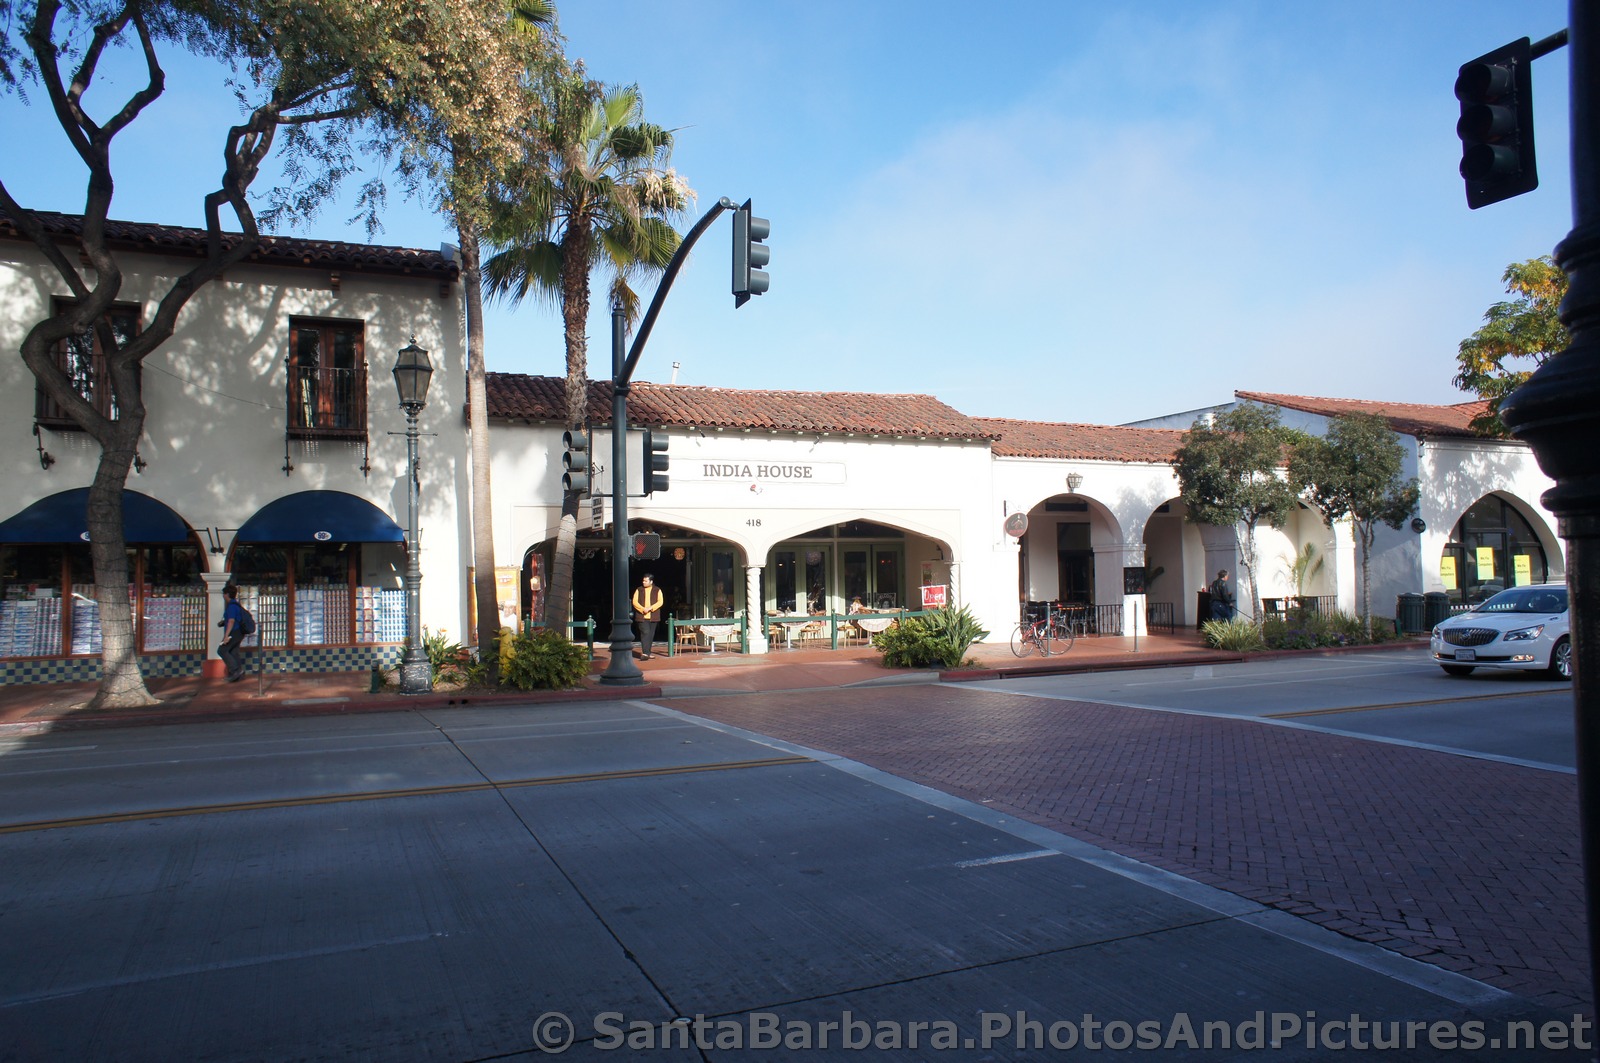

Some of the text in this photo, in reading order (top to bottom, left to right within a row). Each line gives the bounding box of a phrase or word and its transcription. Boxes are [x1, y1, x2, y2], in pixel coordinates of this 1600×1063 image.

[703, 464, 812, 478] INDIA HOUSE
[745, 518, 762, 527] 418
[924, 589, 944, 602] Open
